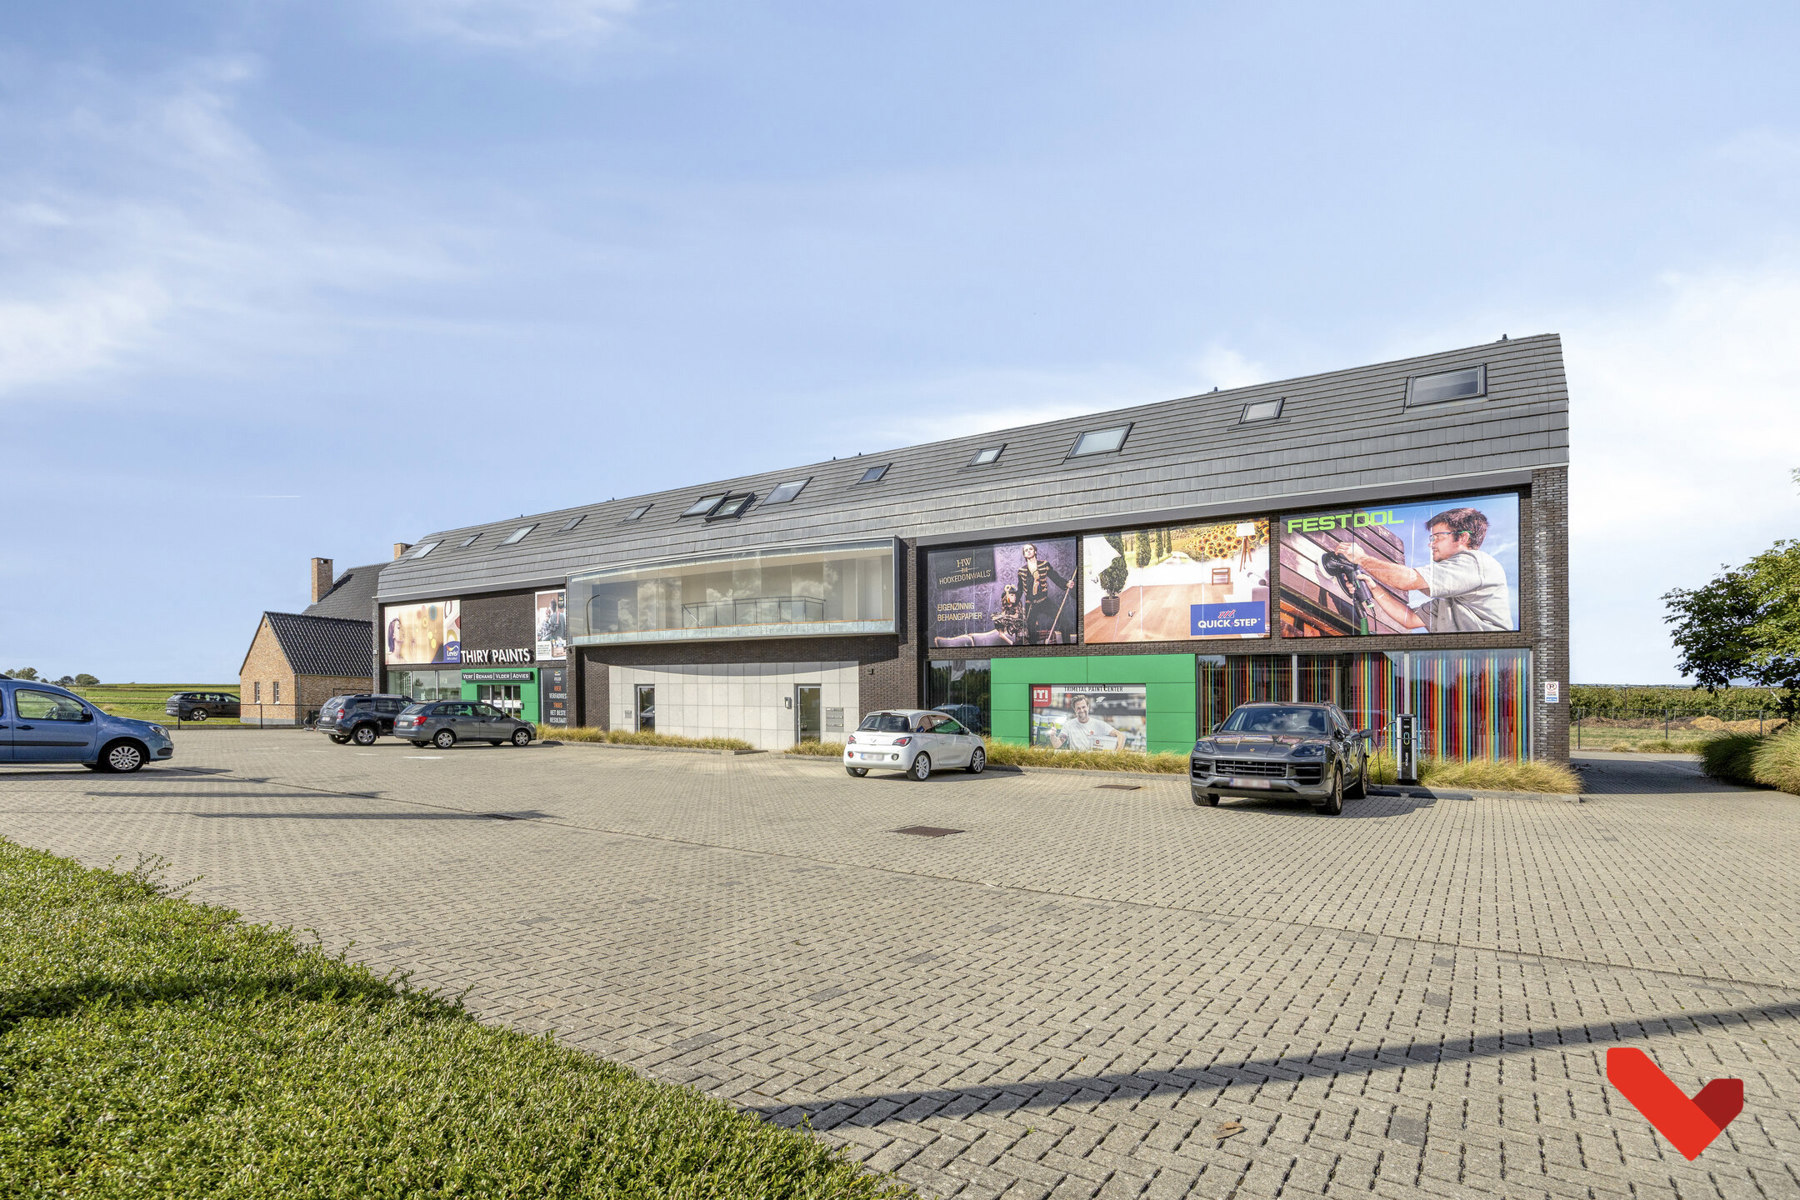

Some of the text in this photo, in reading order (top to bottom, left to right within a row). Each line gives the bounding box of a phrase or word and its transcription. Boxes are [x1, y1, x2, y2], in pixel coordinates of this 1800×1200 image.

[1288, 511, 1404, 533] FESTOOL
[957, 557, 972, 567] HW
[937, 602, 975, 611] EIGENZINNIG
[937, 612, 983, 622] BEHANGPAPIER
[461, 649, 488, 663] THIRY
[491, 648, 531, 662] PAINTS
